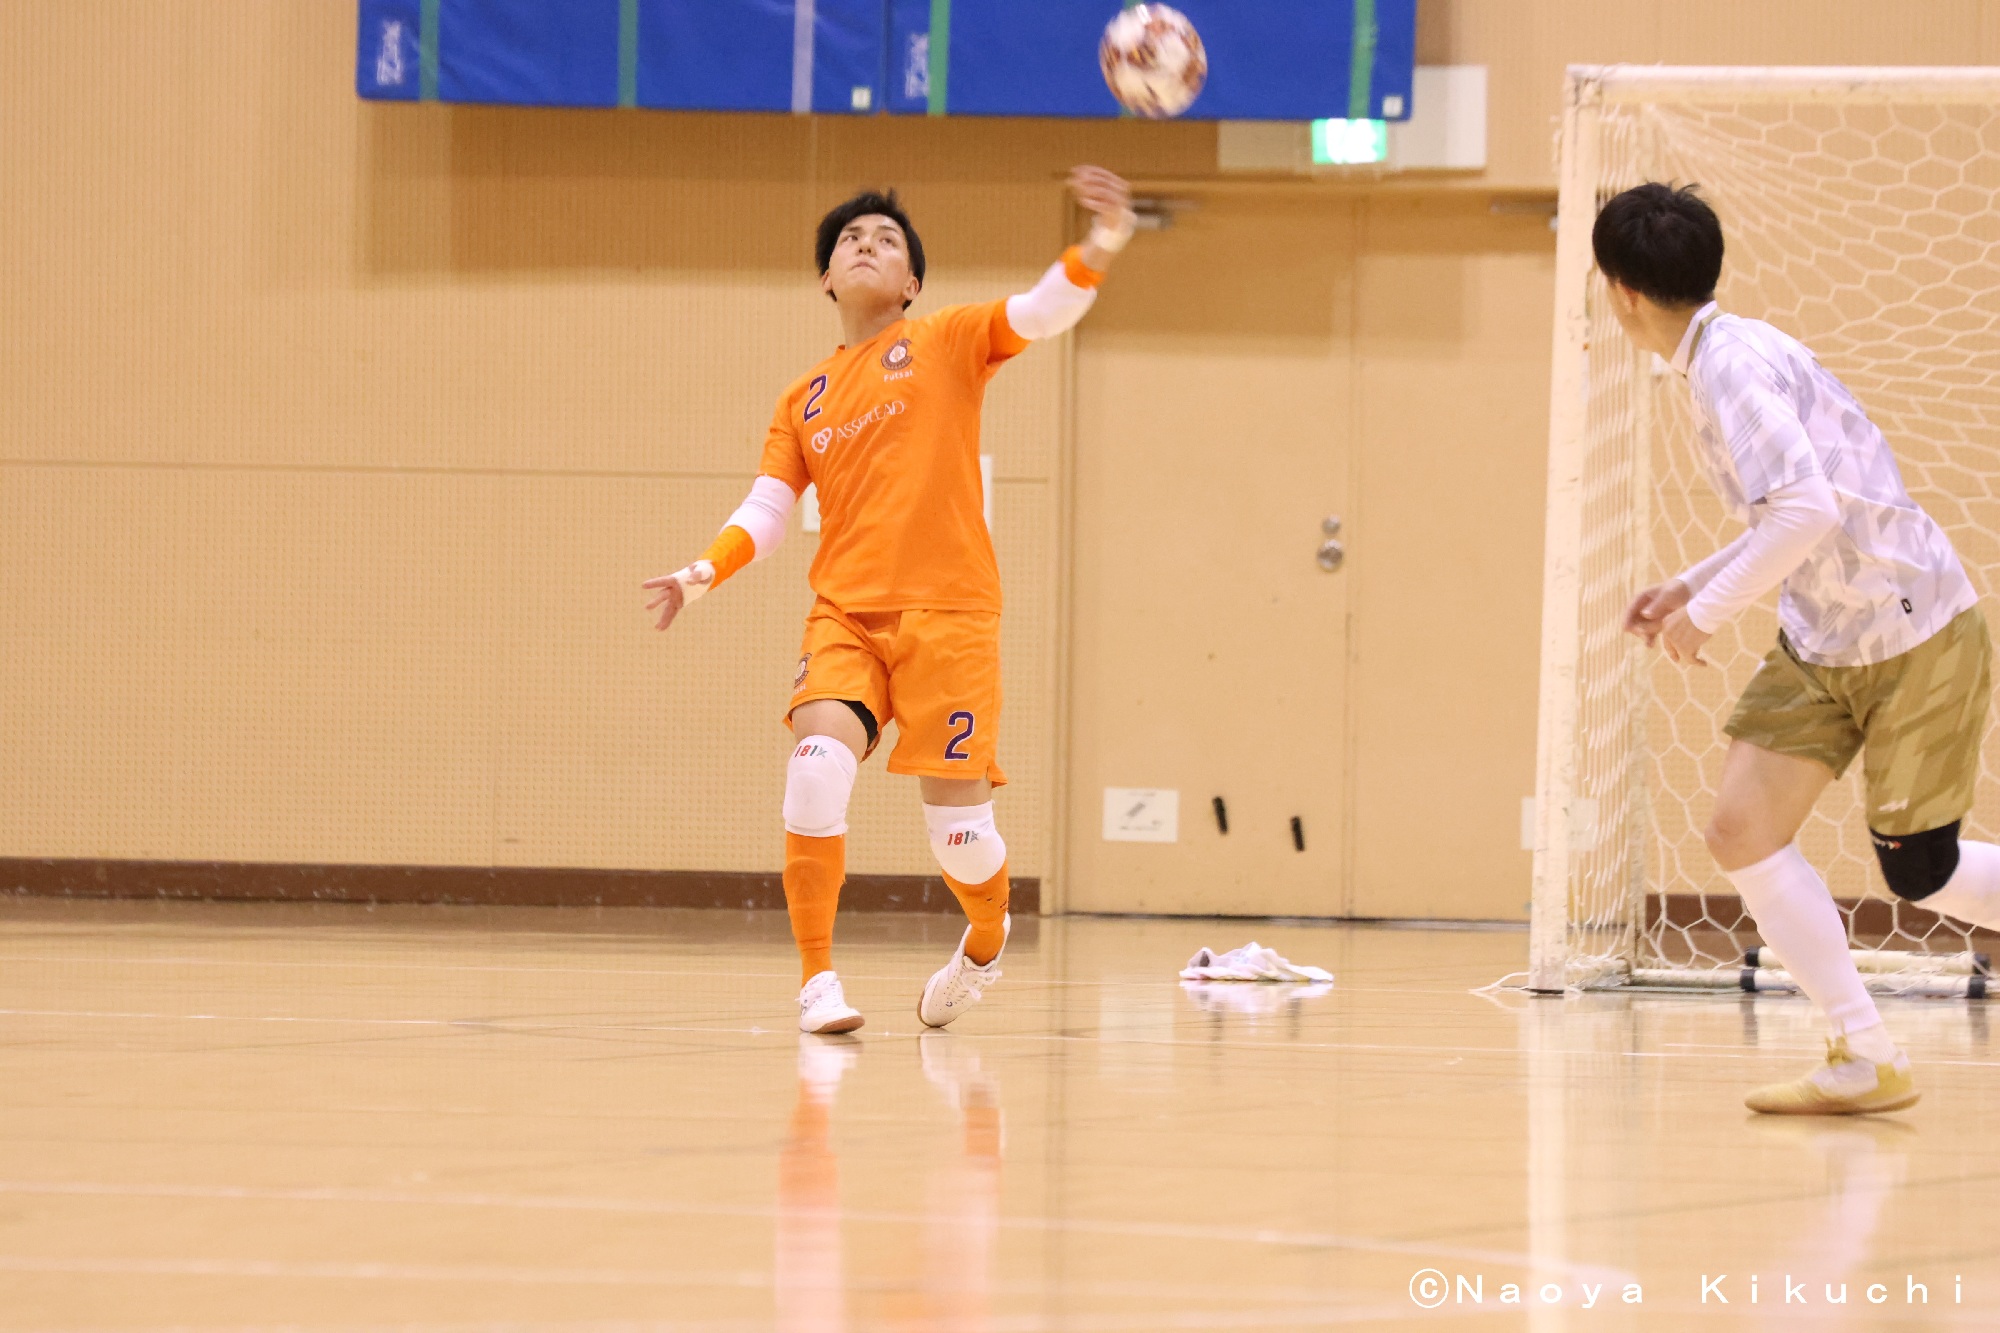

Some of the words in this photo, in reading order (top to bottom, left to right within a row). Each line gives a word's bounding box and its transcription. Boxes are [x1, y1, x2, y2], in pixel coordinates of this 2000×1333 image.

[804, 375, 828, 423] 2
[884, 369, 912, 382] Futsal
[944, 711, 975, 760] 2
